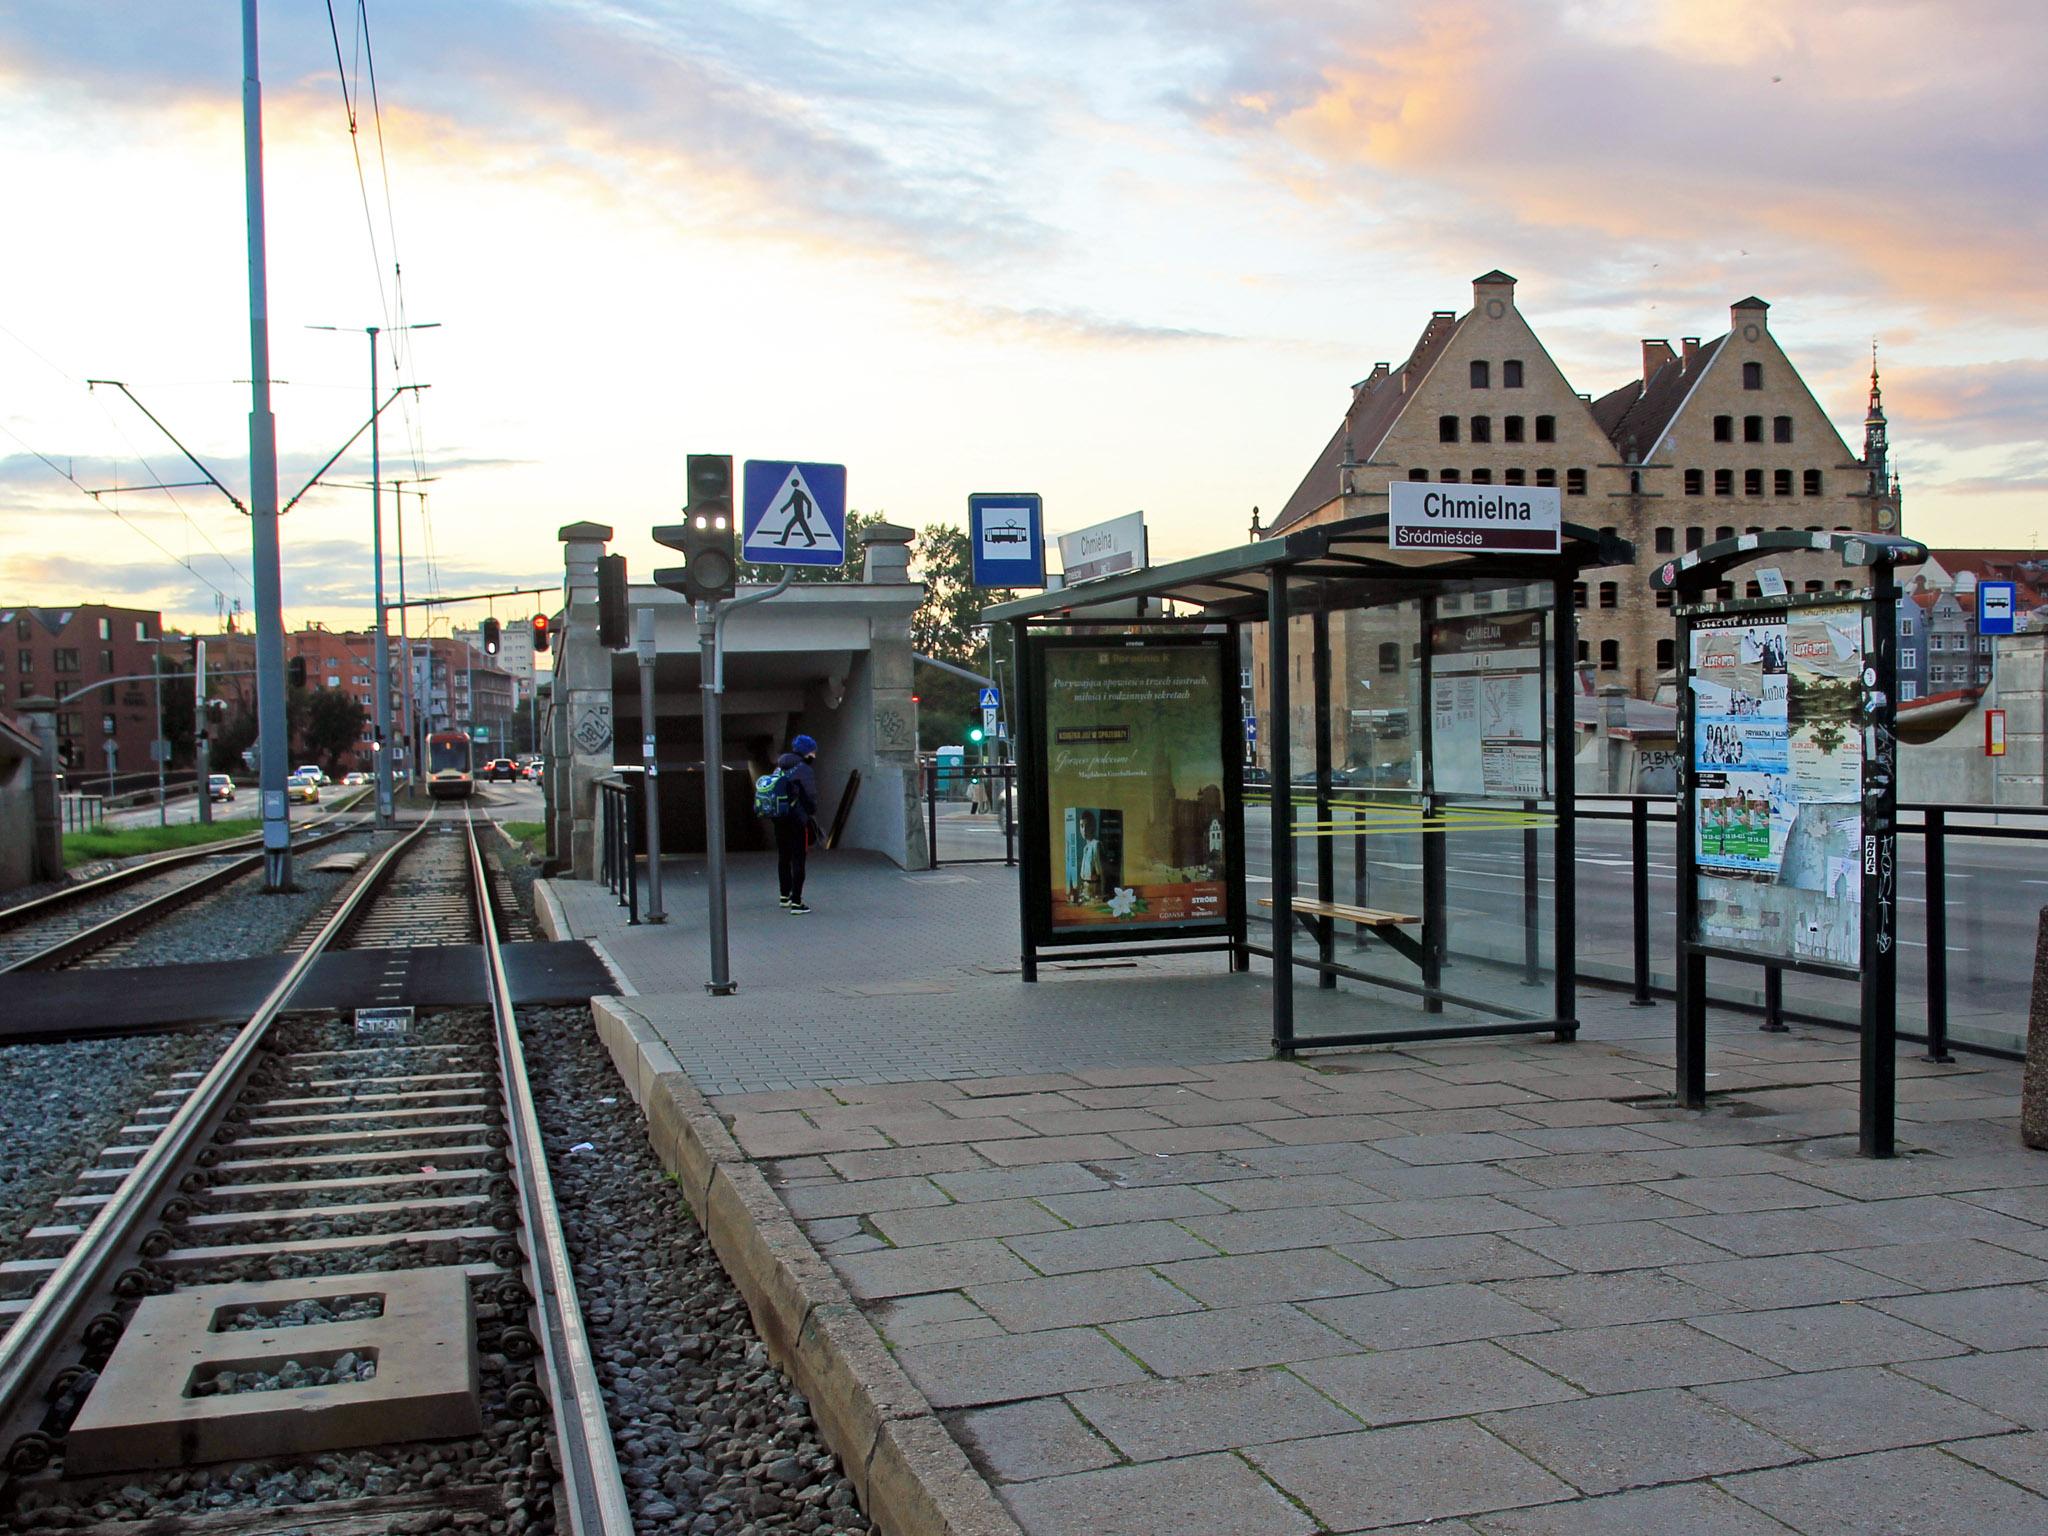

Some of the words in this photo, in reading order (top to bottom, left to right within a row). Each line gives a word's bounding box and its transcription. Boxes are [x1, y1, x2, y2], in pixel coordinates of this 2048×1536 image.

[1423, 492, 1531, 521] Chmielna
[1080, 531, 1112, 556] Chmielna
[1398, 526, 1483, 545] Śródmieście
[1191, 895, 1218, 905] STRÖER
